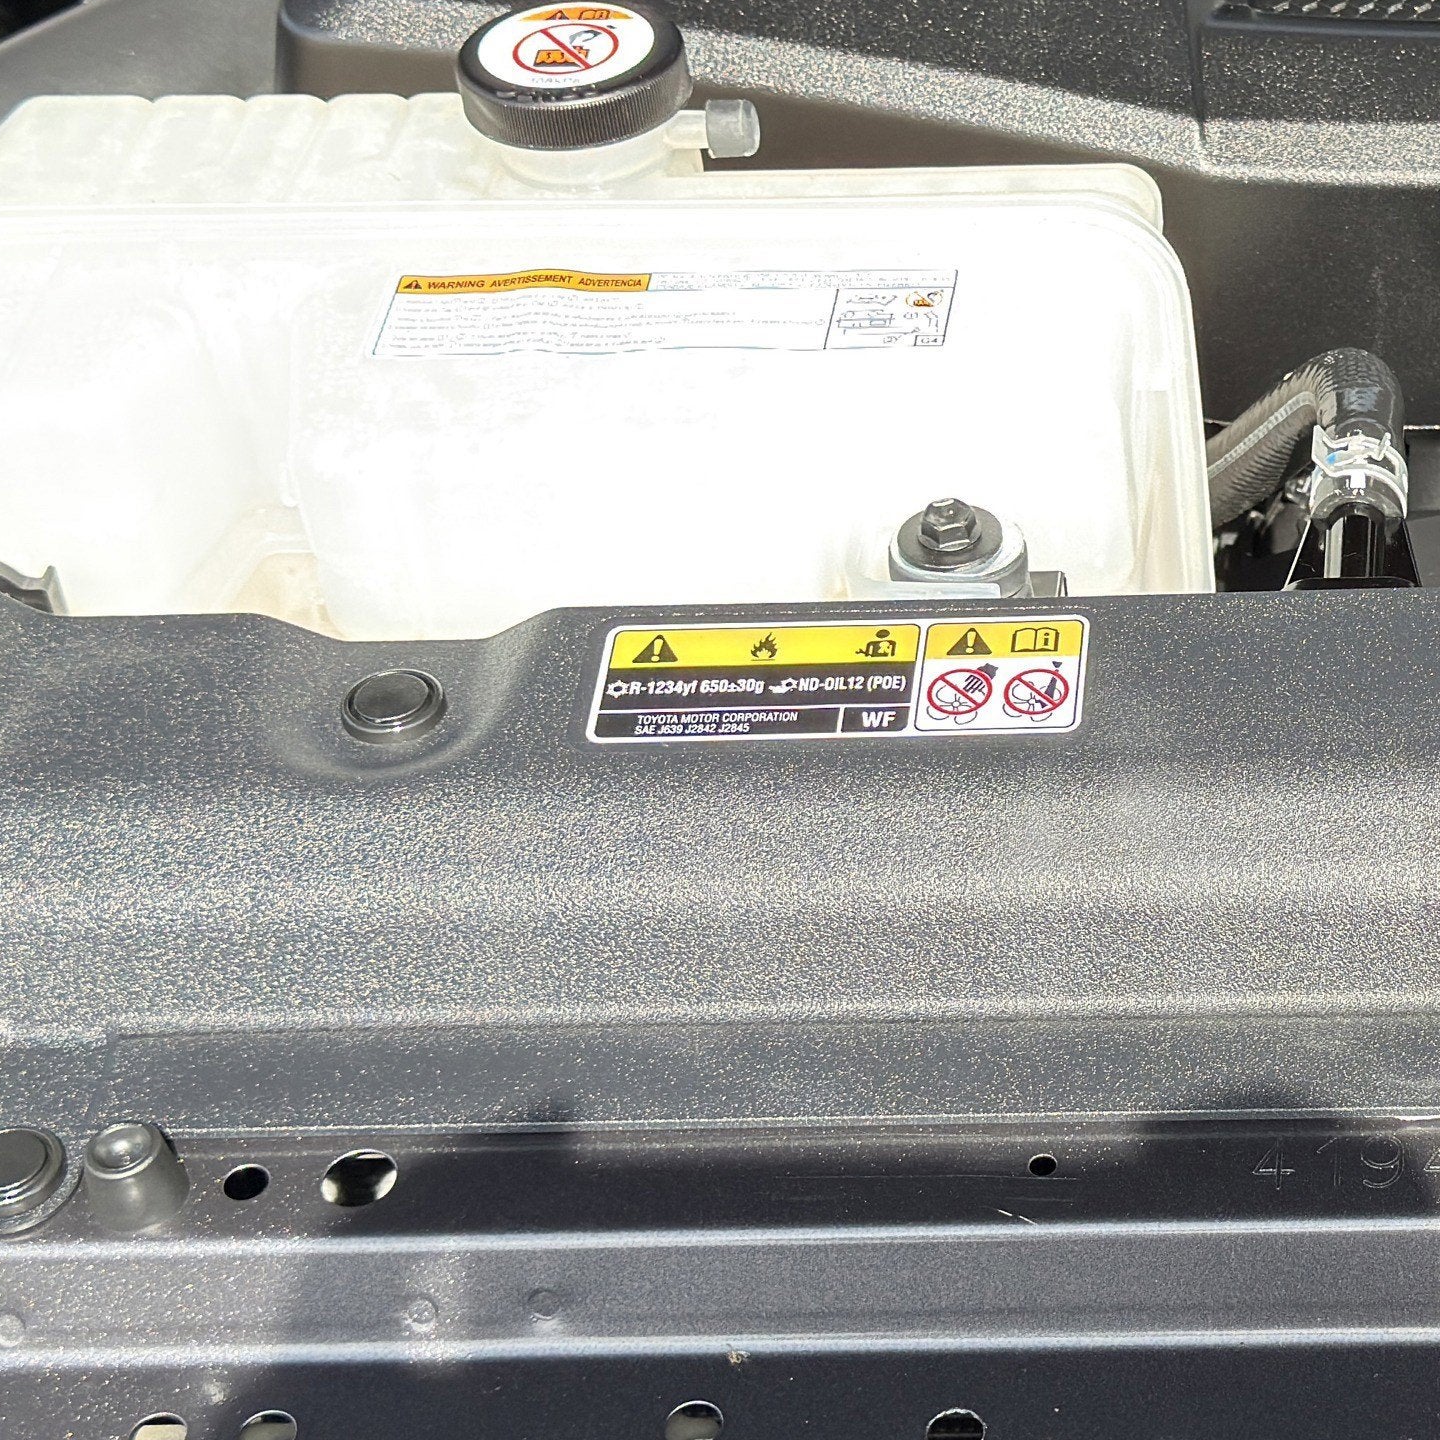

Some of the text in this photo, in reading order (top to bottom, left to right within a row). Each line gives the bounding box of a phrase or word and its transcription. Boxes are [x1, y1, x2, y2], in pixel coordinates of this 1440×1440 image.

[427, 279, 485, 290] WARNING
[489, 274, 574, 289] AVERTISSEMENT
[578, 278, 643, 288] ADVERTENCIA
[629, 675, 907, 696] R-1234yf 650±30g ND-OIL12 (POE)
[637, 712, 798, 725] TOYOTA MOTOR CORPORATION
[861, 711, 897, 728] WF
[634, 723, 750, 735] SAE J639 J2842 J2845
